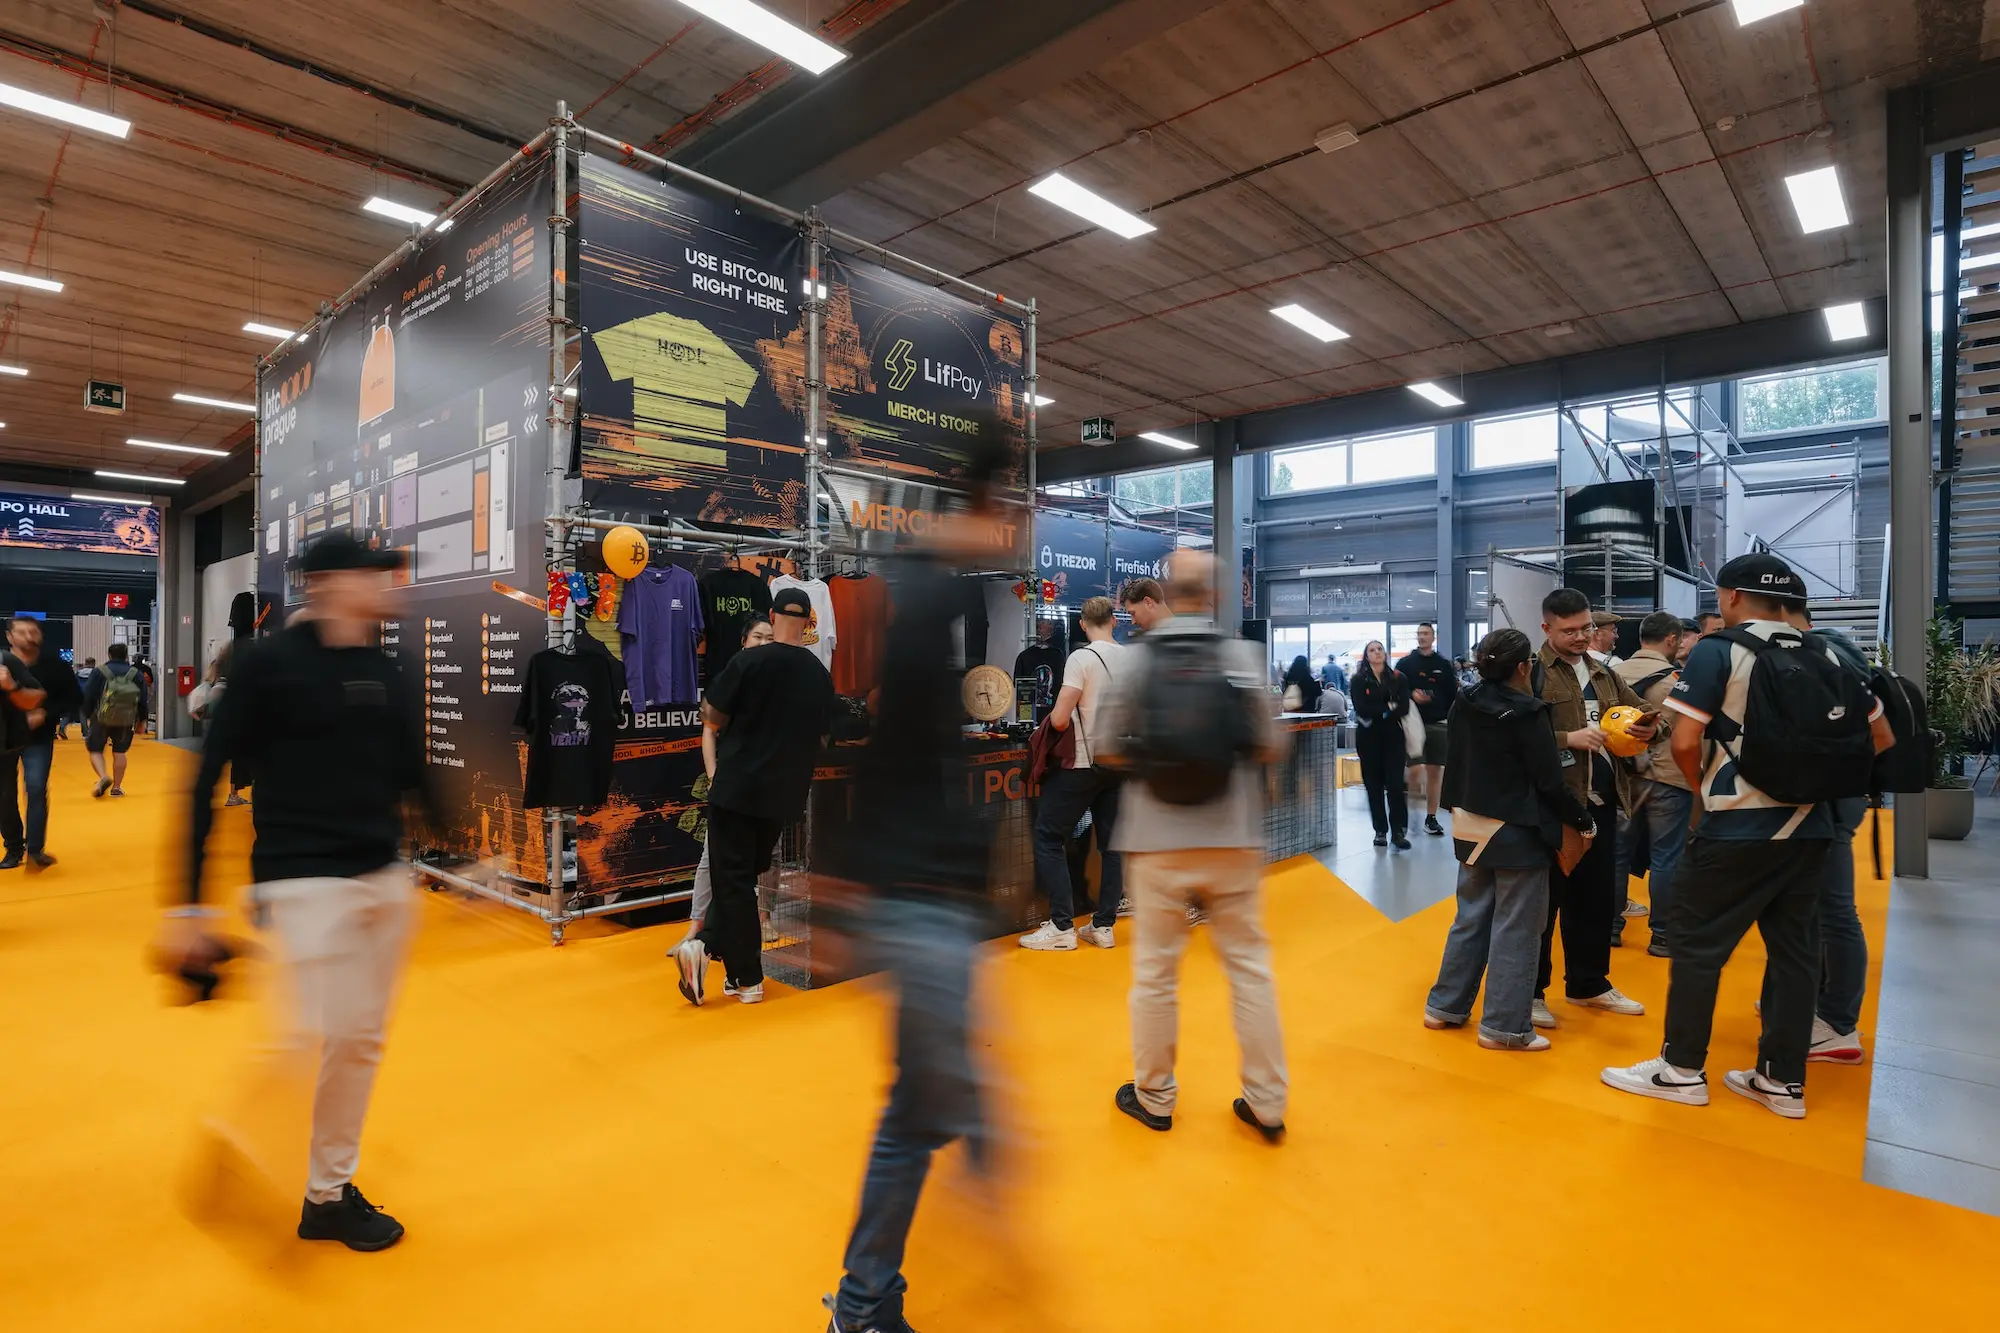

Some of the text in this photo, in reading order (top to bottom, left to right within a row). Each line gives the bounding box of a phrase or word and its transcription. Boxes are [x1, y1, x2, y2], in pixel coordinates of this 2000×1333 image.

[466, 213, 528, 263] Opening Hours
[465, 265, 476, 277] THU
[685, 247, 789, 294] USE BITCOIN.
[465, 278, 473, 290] FRI
[692, 272, 789, 315] RIGHT HERE.
[402, 288, 417, 304] Free
[464, 289, 475, 302] SAT
[924, 357, 982, 400] LifPay
[265, 388, 281, 421] btc
[888, 400, 980, 436] MERCH STORE
[265, 406, 297, 456] prague
[0, 501, 70, 517] PO HALL
[1055, 552, 1097, 571] TREZOR
[1115, 557, 1151, 576] Firefish
[489, 649, 514, 661] EasyLight
[634, 710, 703, 729] BELIEVE
[550, 732, 590, 746] VERIFY
[639, 745, 666, 755] #HODL
[672, 739, 698, 749] #HODL
